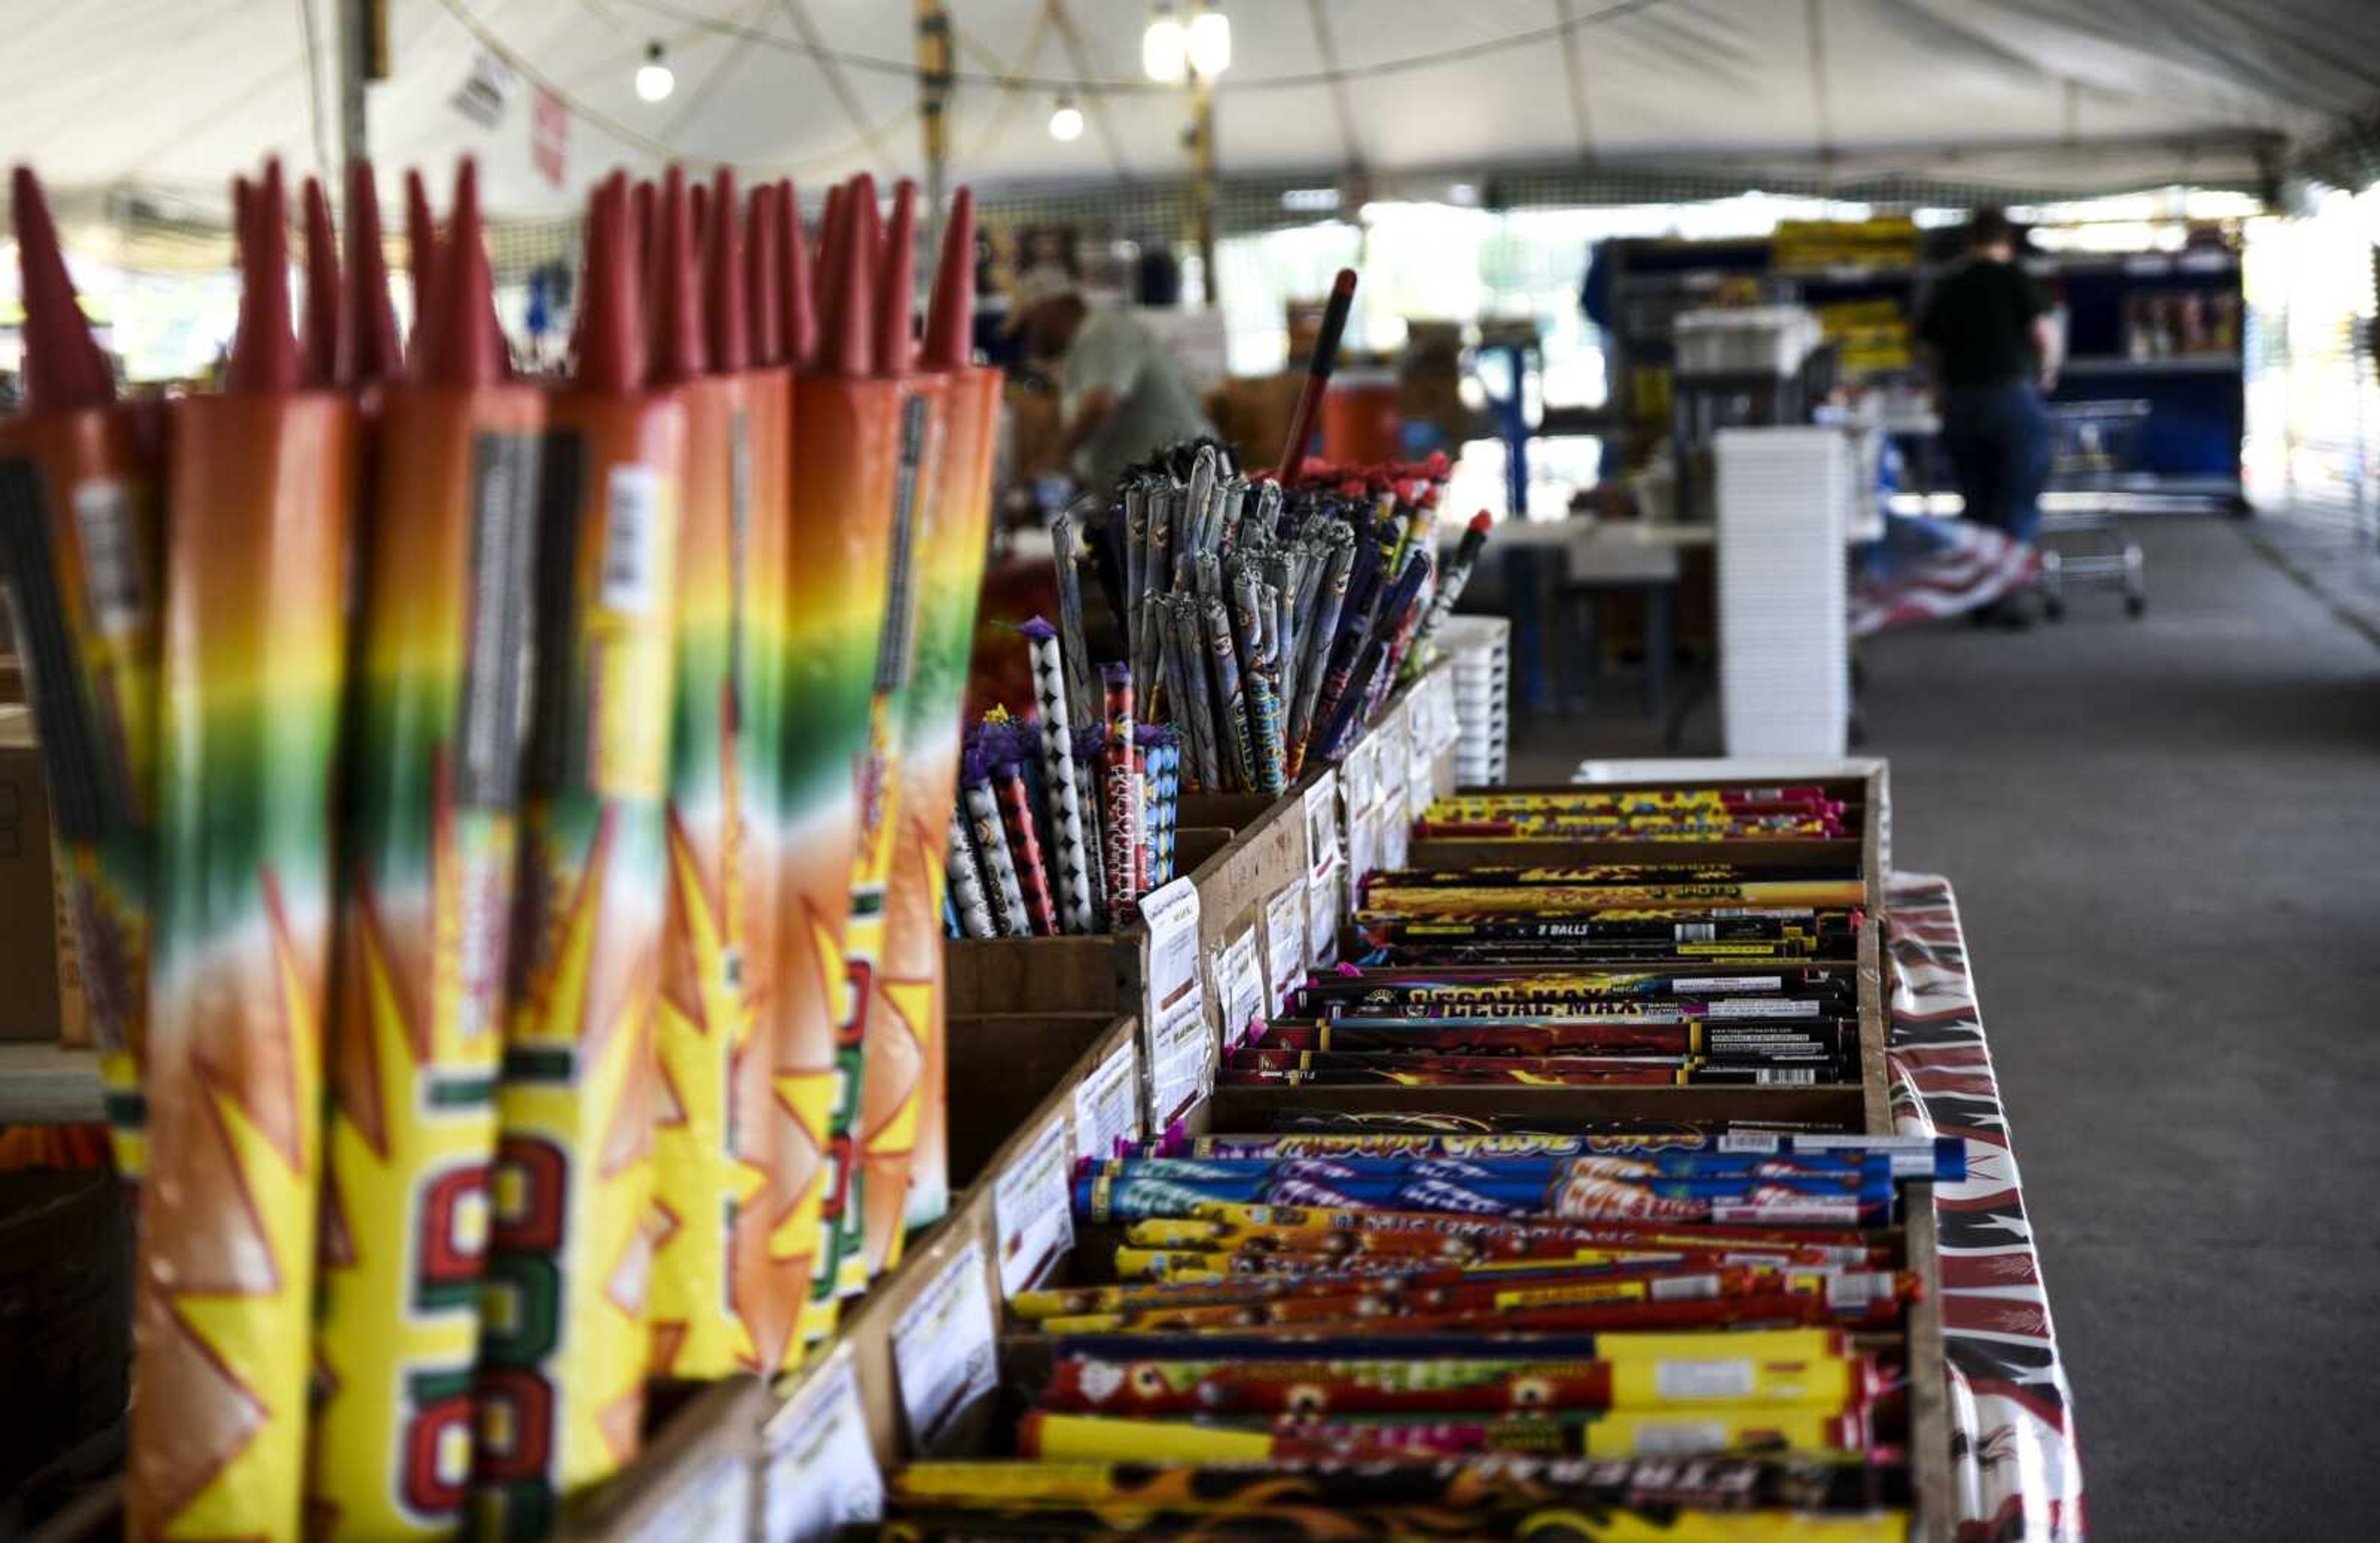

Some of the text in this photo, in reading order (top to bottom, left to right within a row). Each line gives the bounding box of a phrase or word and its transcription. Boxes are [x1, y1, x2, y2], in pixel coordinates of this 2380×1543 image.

[1549, 923, 1589, 937] BALLS
[1443, 1002, 1556, 1018] LEGAL
[1568, 1001, 1645, 1018] MAX
